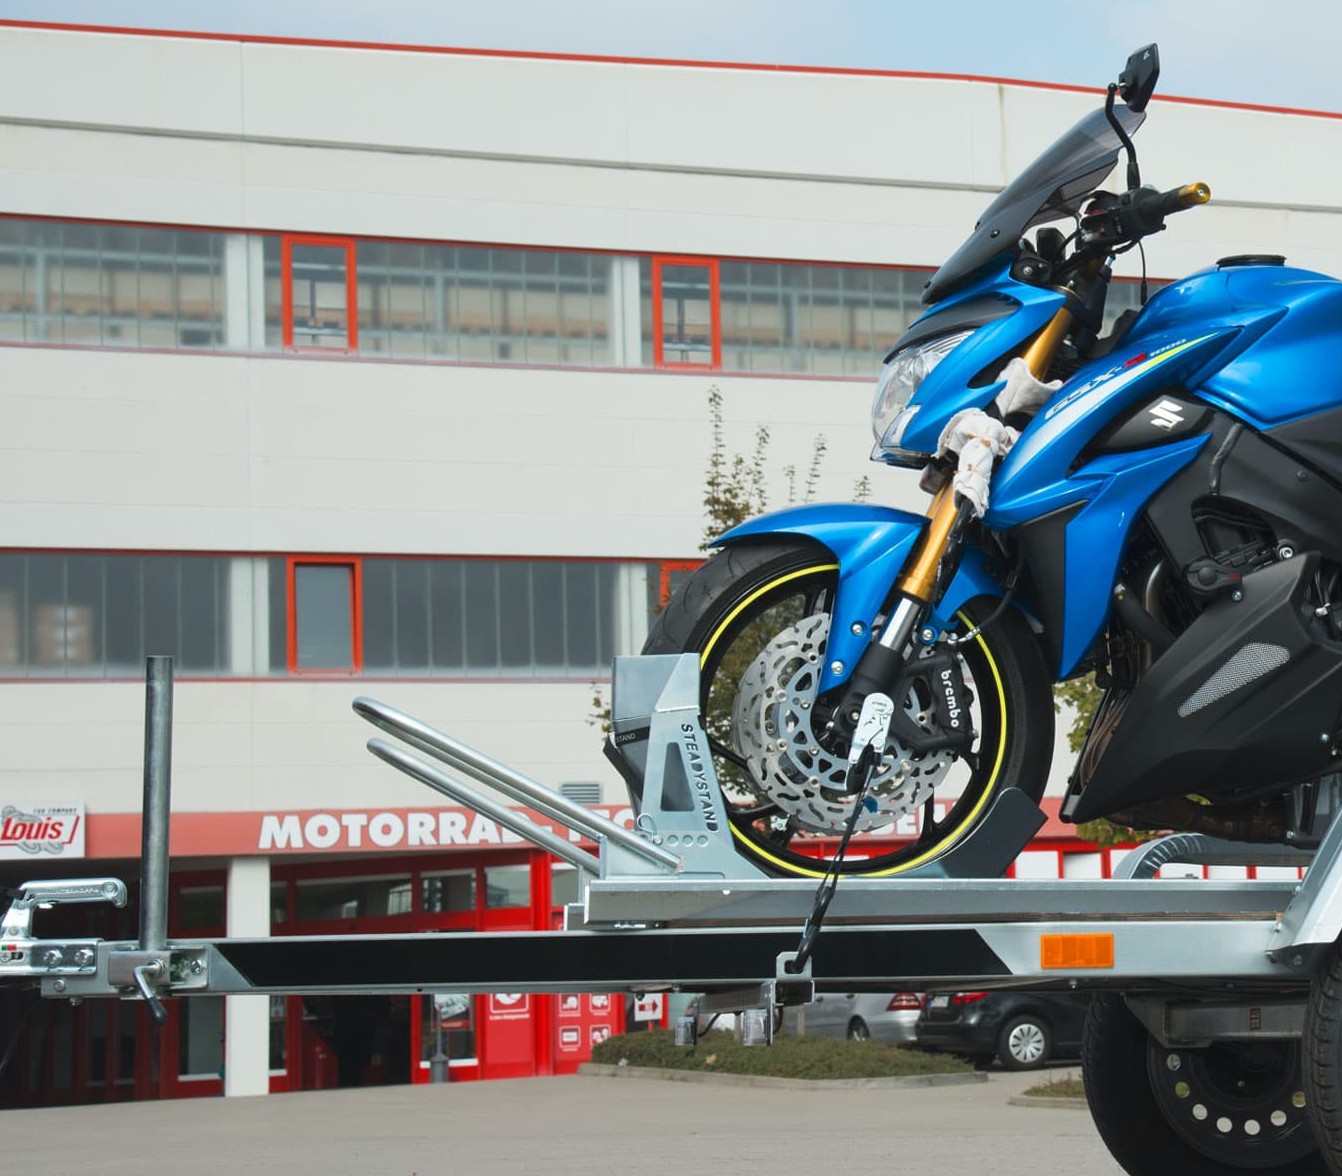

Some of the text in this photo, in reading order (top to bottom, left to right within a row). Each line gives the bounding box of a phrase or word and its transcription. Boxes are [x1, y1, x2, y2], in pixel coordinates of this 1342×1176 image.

[940, 669, 962, 729] brembo
[681, 723, 719, 832] STEADYSTAND
[0, 816, 65, 841] Louis
